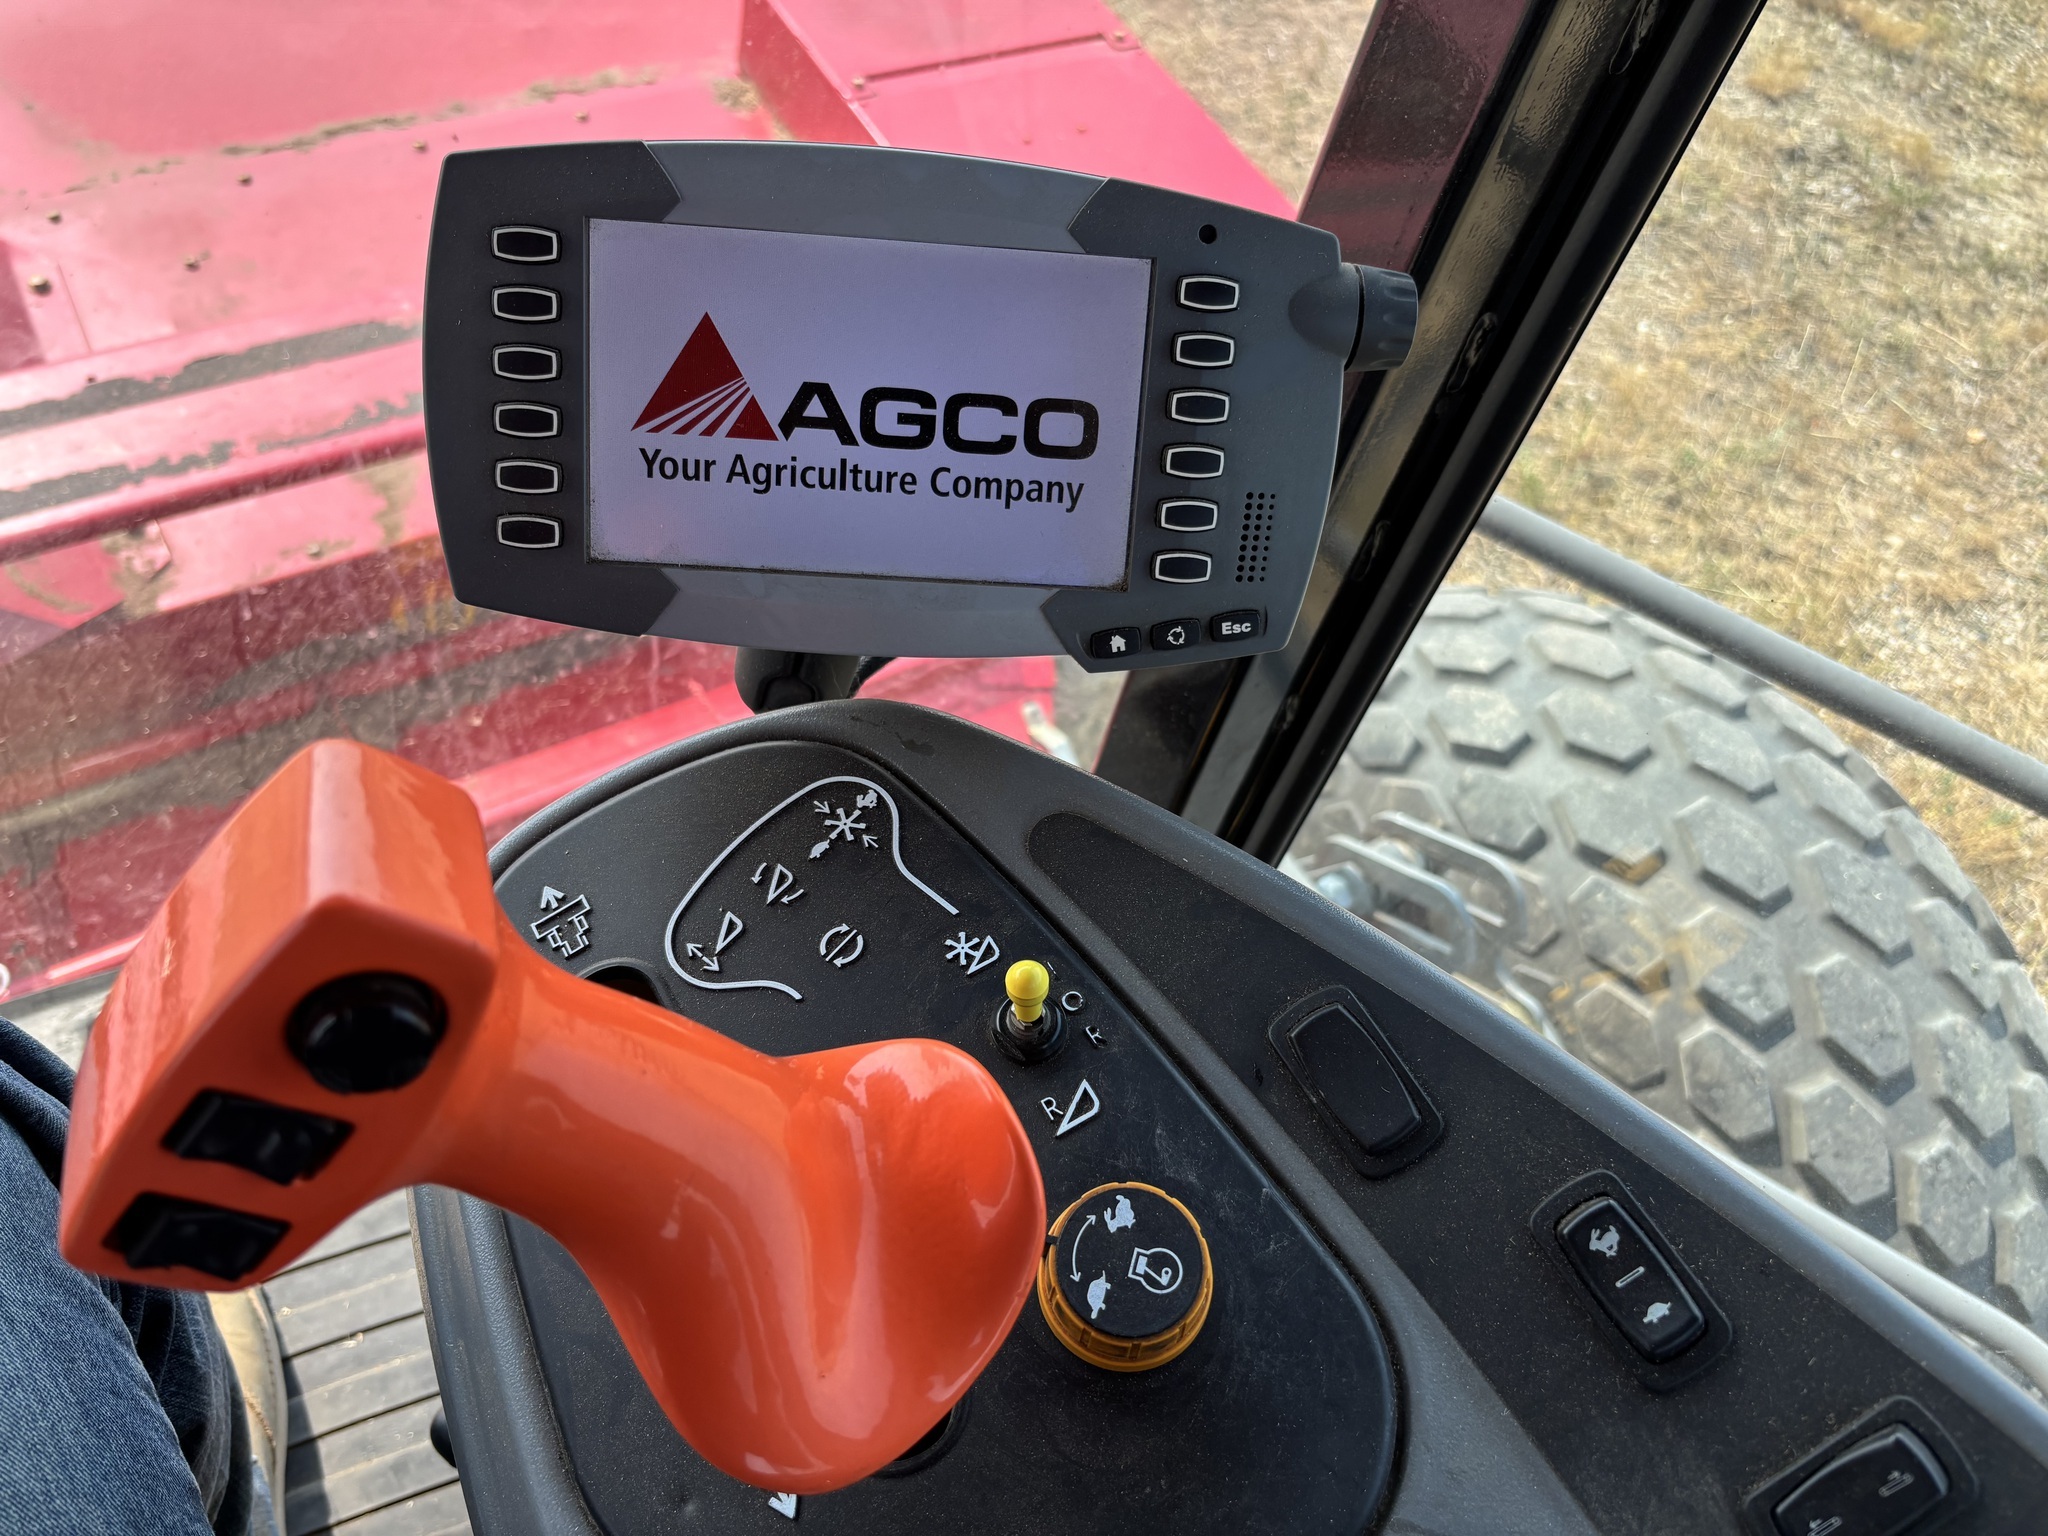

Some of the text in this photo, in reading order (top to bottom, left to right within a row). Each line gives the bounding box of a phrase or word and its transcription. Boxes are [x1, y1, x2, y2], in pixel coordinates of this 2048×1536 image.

[777, 381, 1099, 460] AGCO
[638, 447, 1085, 513] Your Agriculture Company
[1221, 621, 1252, 635] Esc
[1041, 1097, 1063, 1120] R
